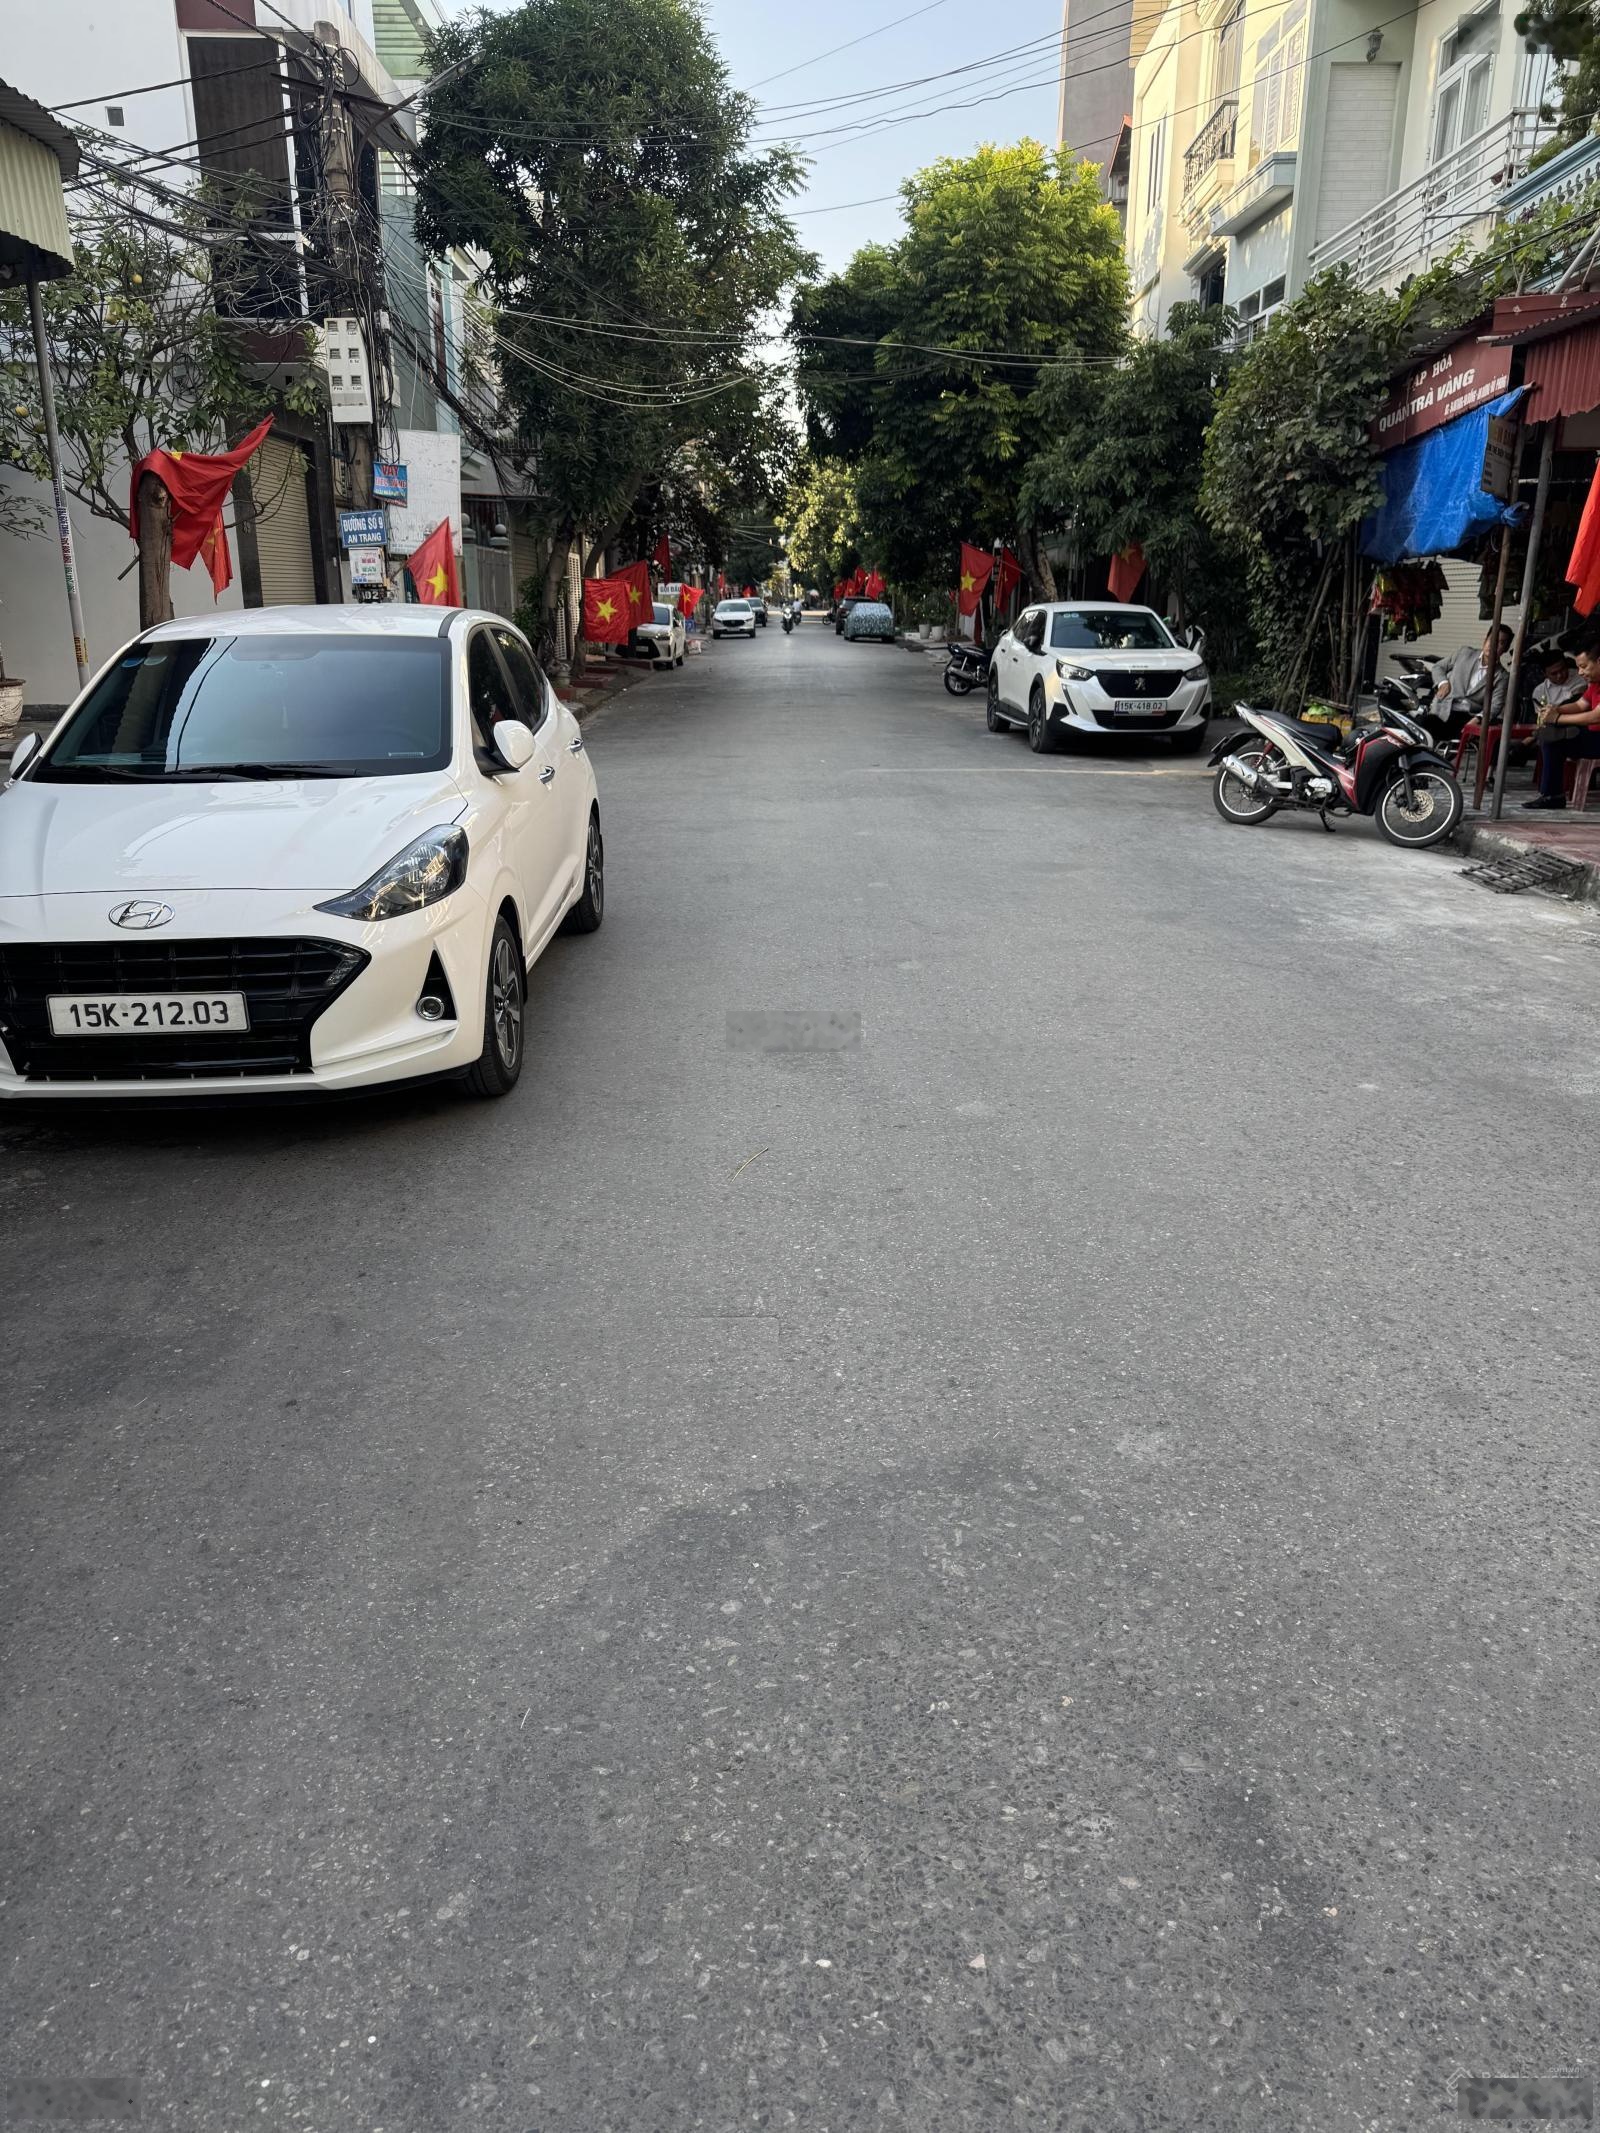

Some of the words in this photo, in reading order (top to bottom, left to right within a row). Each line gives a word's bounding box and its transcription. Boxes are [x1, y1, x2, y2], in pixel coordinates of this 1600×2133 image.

[1411, 386, 1434, 416] TRÀ
[1437, 368, 1476, 402] VÀNG
[343, 515, 367, 532] ĐƯỜNG
[368, 513, 377, 530] SỐ
[378, 516, 384, 529] 9
[348, 535, 358, 544] AN
[359, 533, 382, 543] TRANG
[70, 1000, 229, 1028] 15K-212.03
